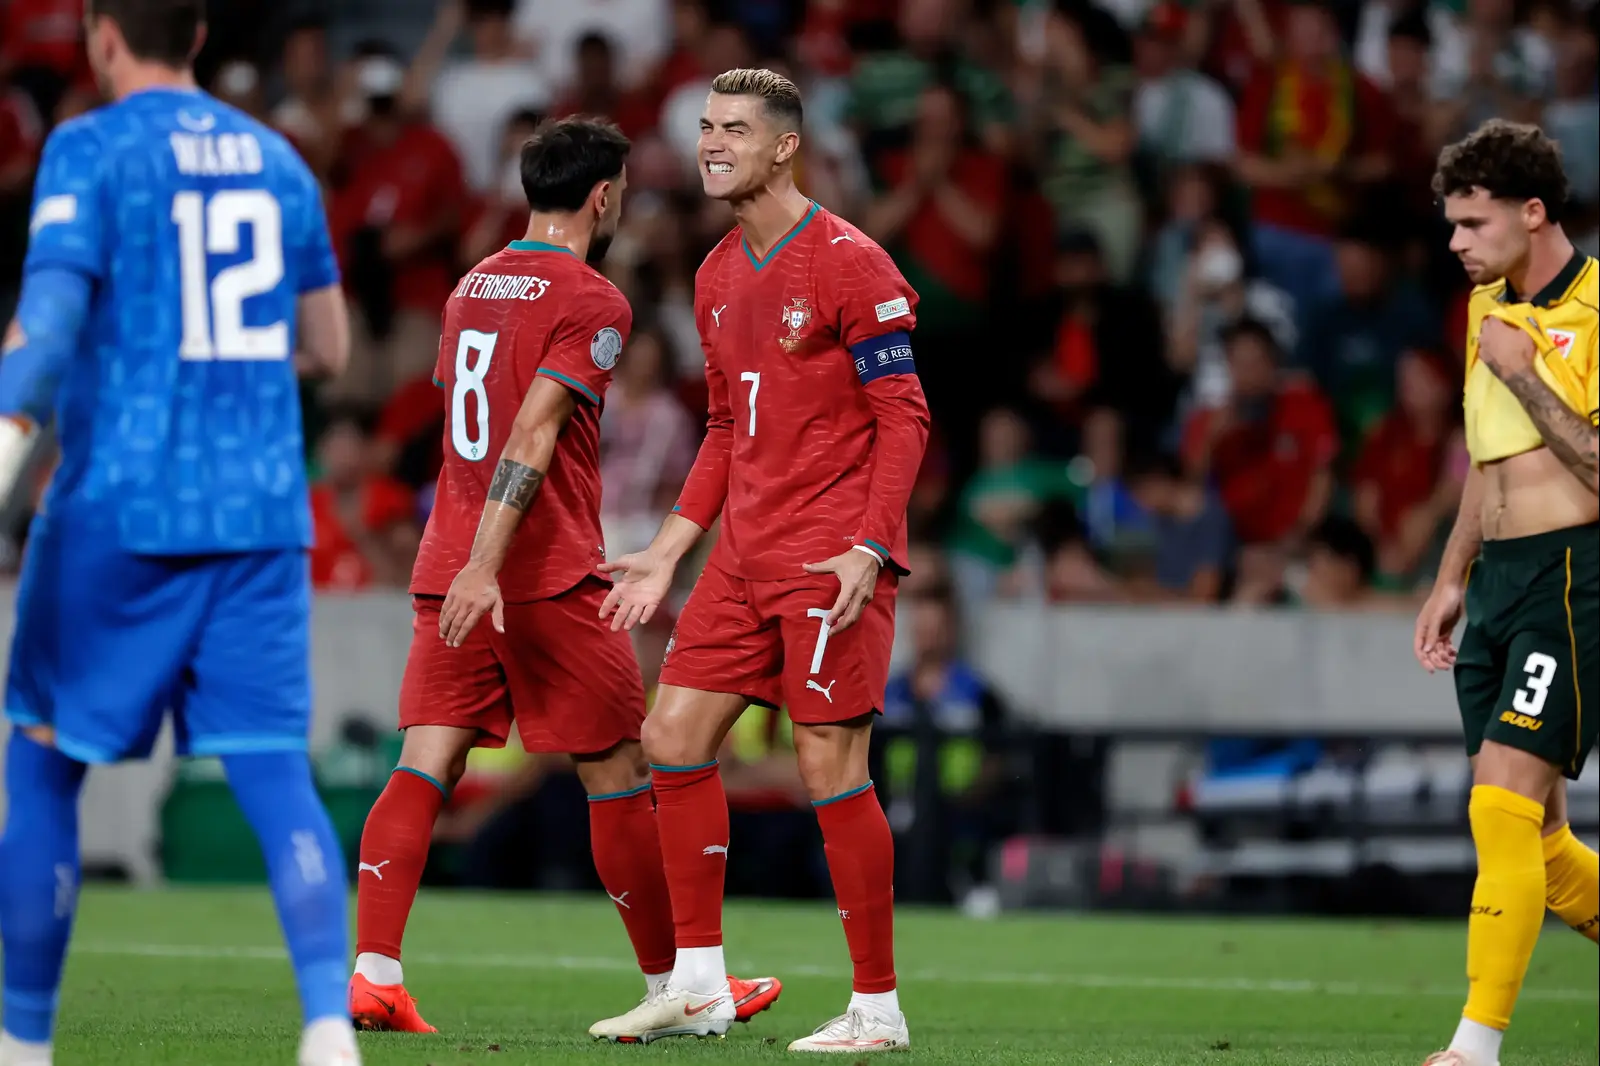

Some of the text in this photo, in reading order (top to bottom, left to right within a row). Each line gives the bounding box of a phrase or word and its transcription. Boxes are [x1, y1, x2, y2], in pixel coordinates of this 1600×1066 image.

[171, 189, 288, 361] 12
[452, 329, 498, 462] 8
[741, 372, 760, 437] 7
[807, 608, 832, 674] 7
[1512, 652, 1558, 717] 3
[1499, 711, 1543, 731] SUDU
